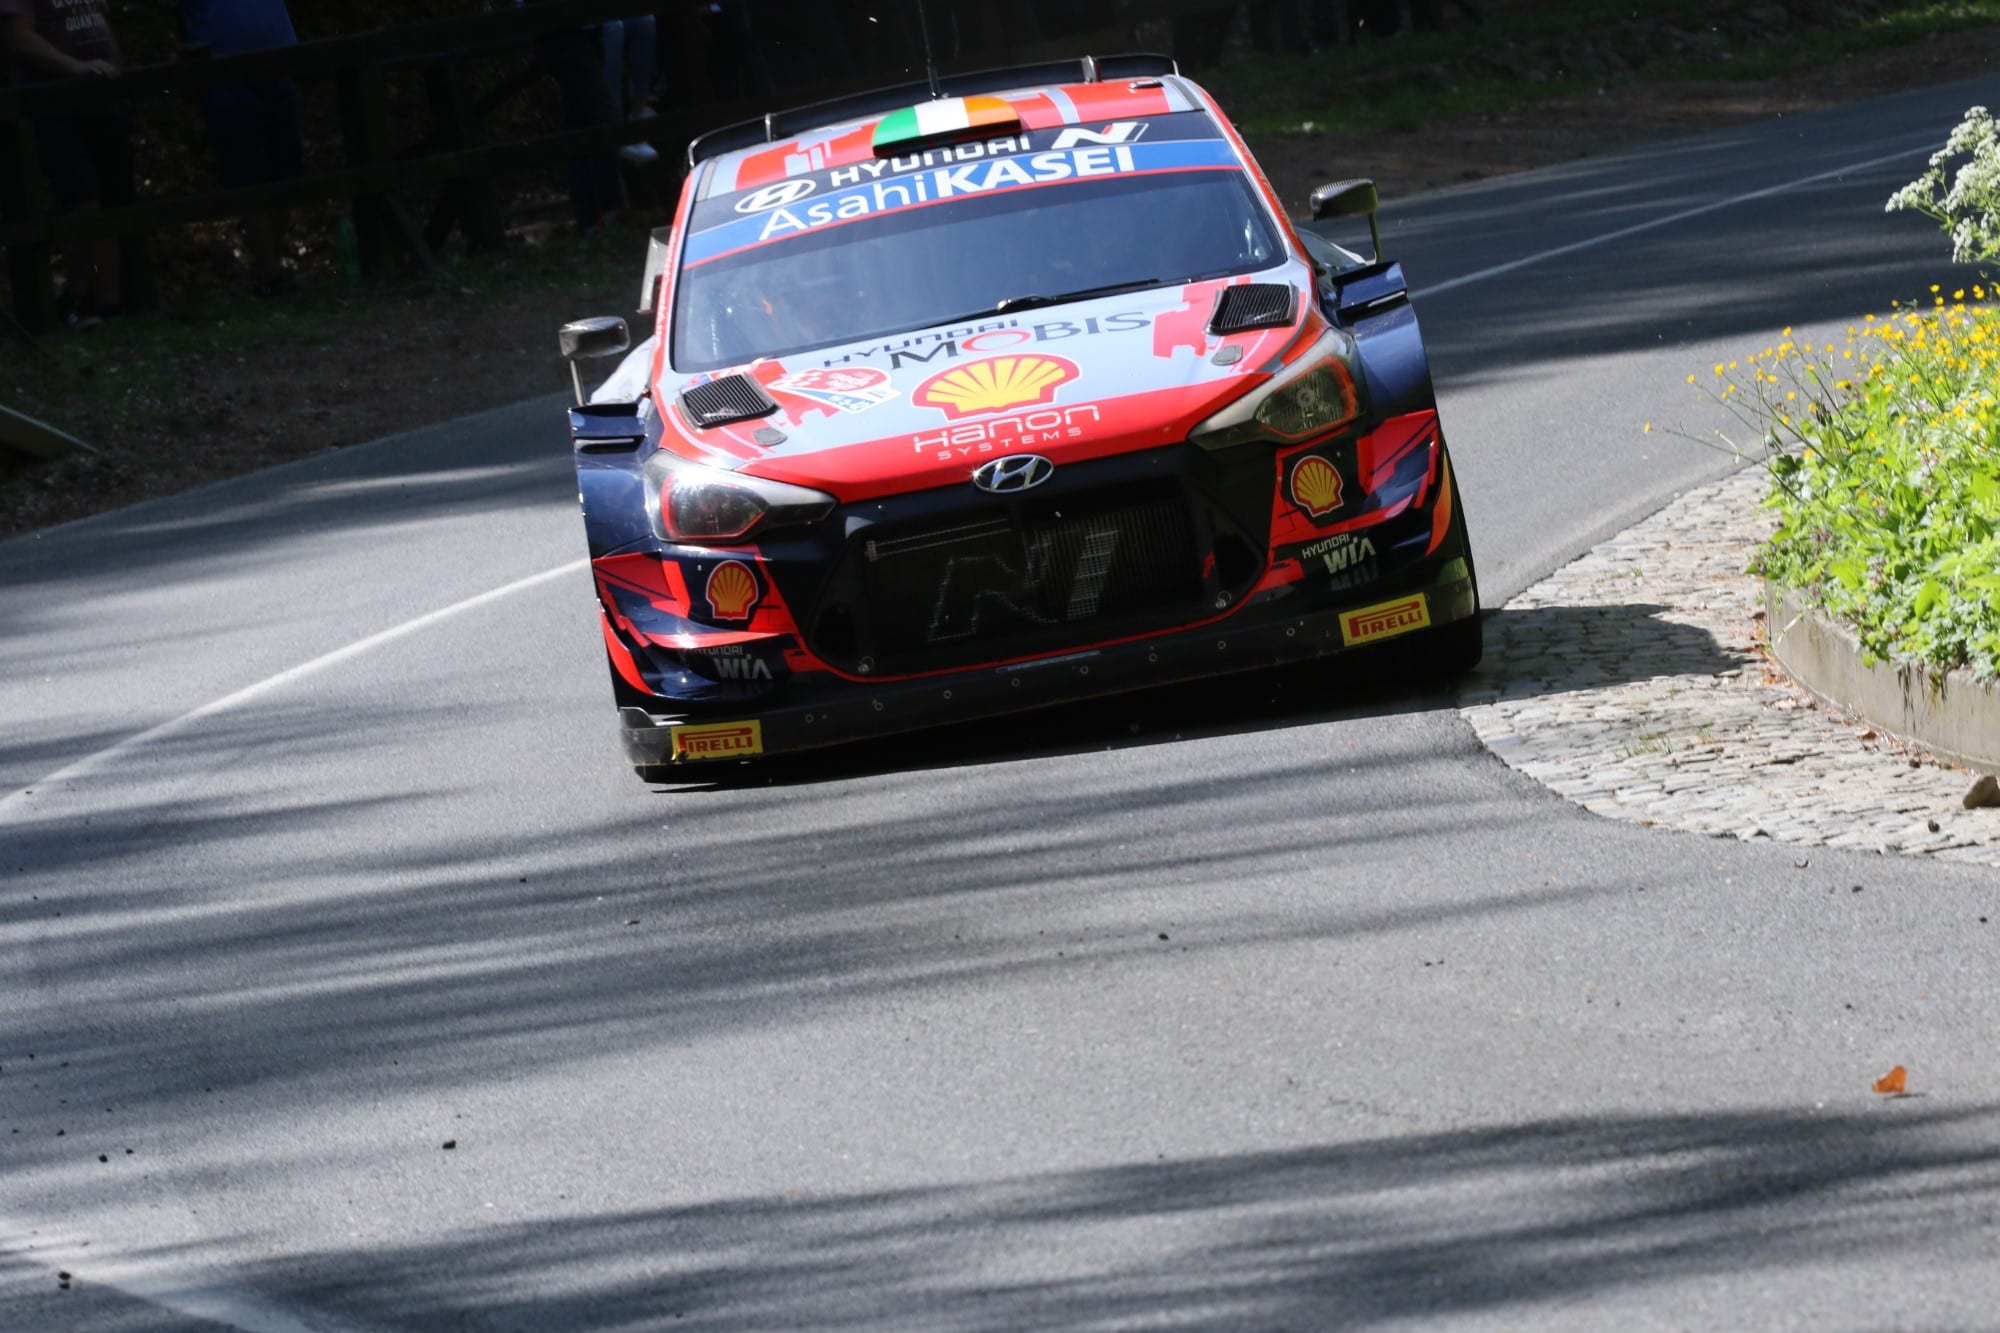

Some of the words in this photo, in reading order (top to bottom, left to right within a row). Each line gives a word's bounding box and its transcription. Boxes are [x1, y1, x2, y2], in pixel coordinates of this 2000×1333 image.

[831, 136, 1031, 188] HYUNDAI
[824, 319, 1018, 368] HYUNDAI
[890, 311, 1152, 370] MOBIS
[938, 426, 1082, 460] SYSTEMS
[1302, 533, 1350, 559] HYUNDAI
[1322, 536, 1377, 575] WIA
[1348, 601, 1423, 639] PIRELLI
[713, 654, 774, 680] WIA
[677, 727, 753, 753] PIRELLI
